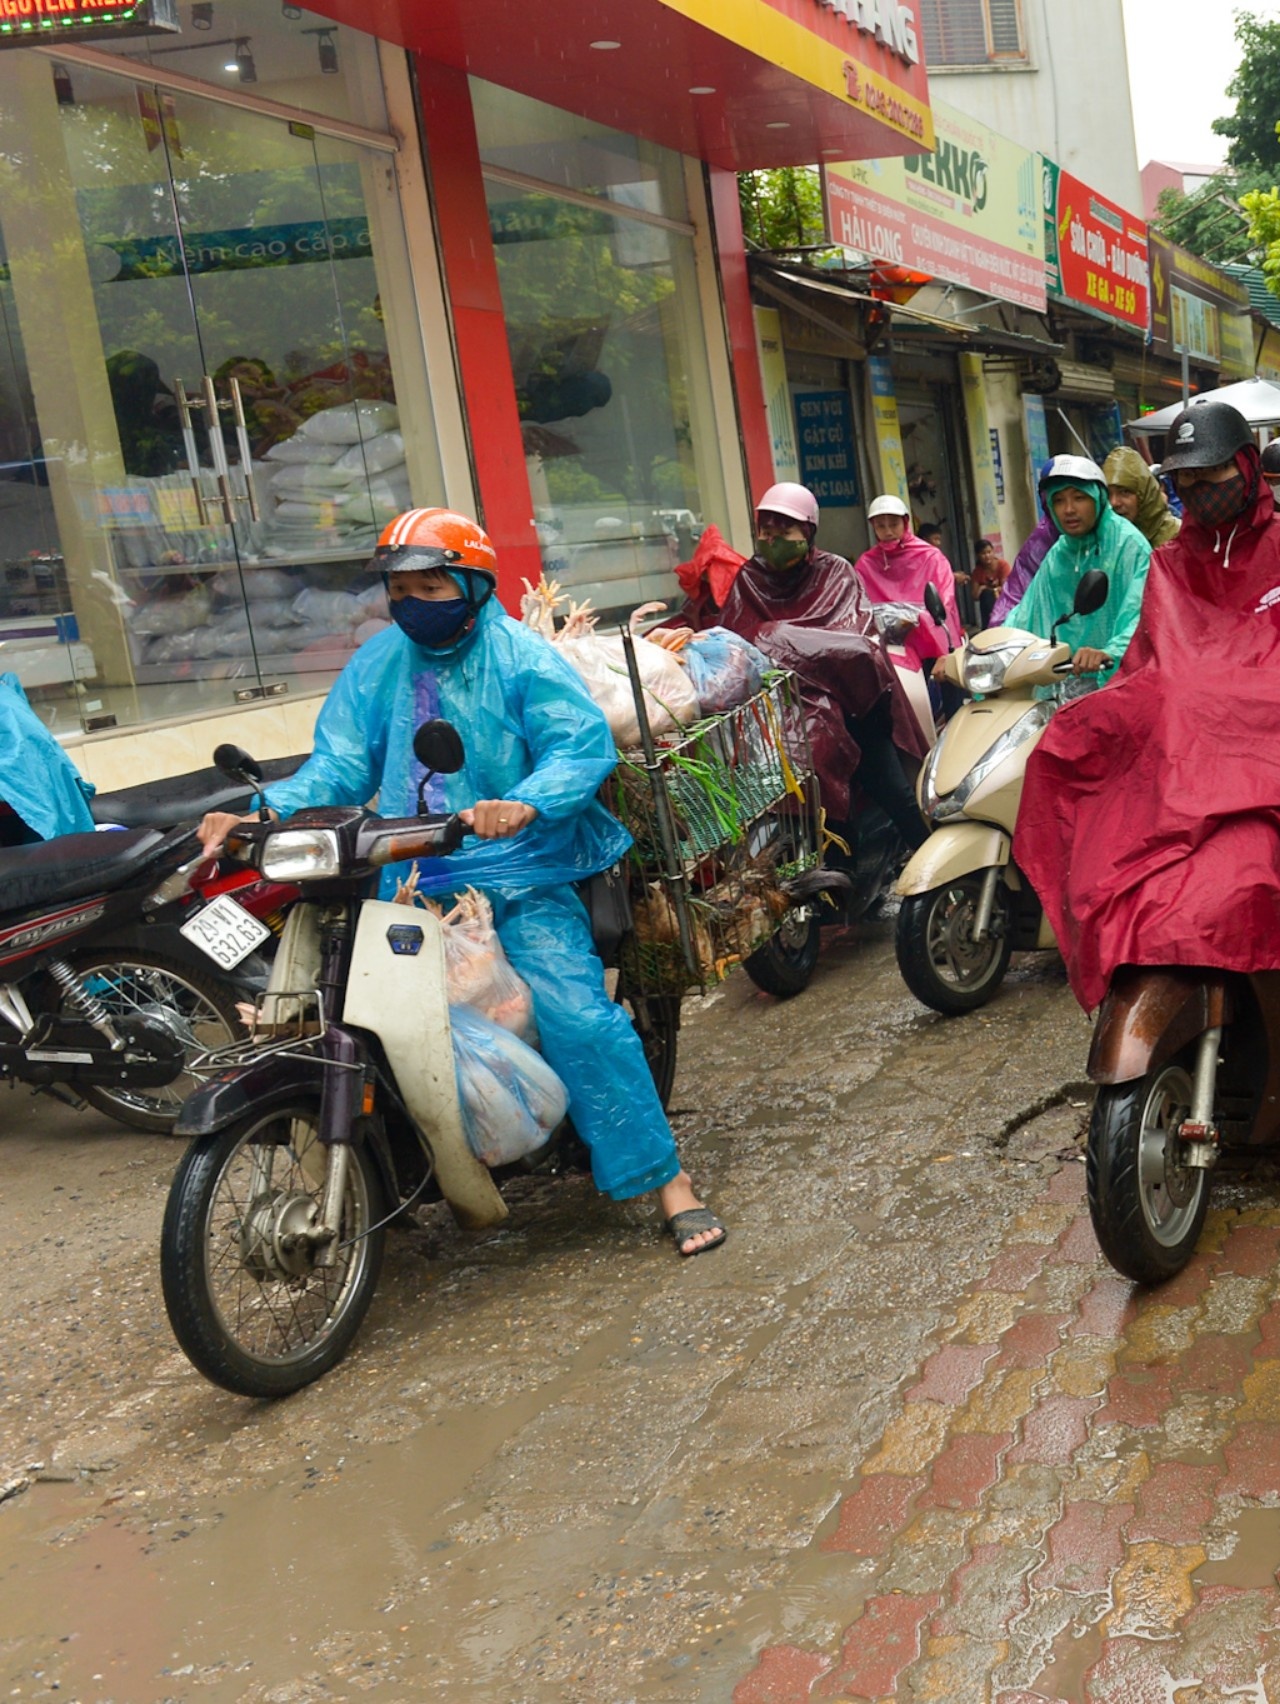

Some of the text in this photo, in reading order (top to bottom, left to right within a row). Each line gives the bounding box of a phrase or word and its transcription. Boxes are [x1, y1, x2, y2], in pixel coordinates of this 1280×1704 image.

[234, 240, 287, 258] cao
[841, 205, 903, 263] HẢI LONG
[1087, 270, 1097, 299] XE
[1098, 277, 1110, 304] GA
[1114, 285, 1125, 311] XE
[800, 400, 821, 417] SEN
[805, 454, 826, 471] KIM
[192, 903, 238, 943] 29-V1
[211, 918, 263, 964] 632.63
